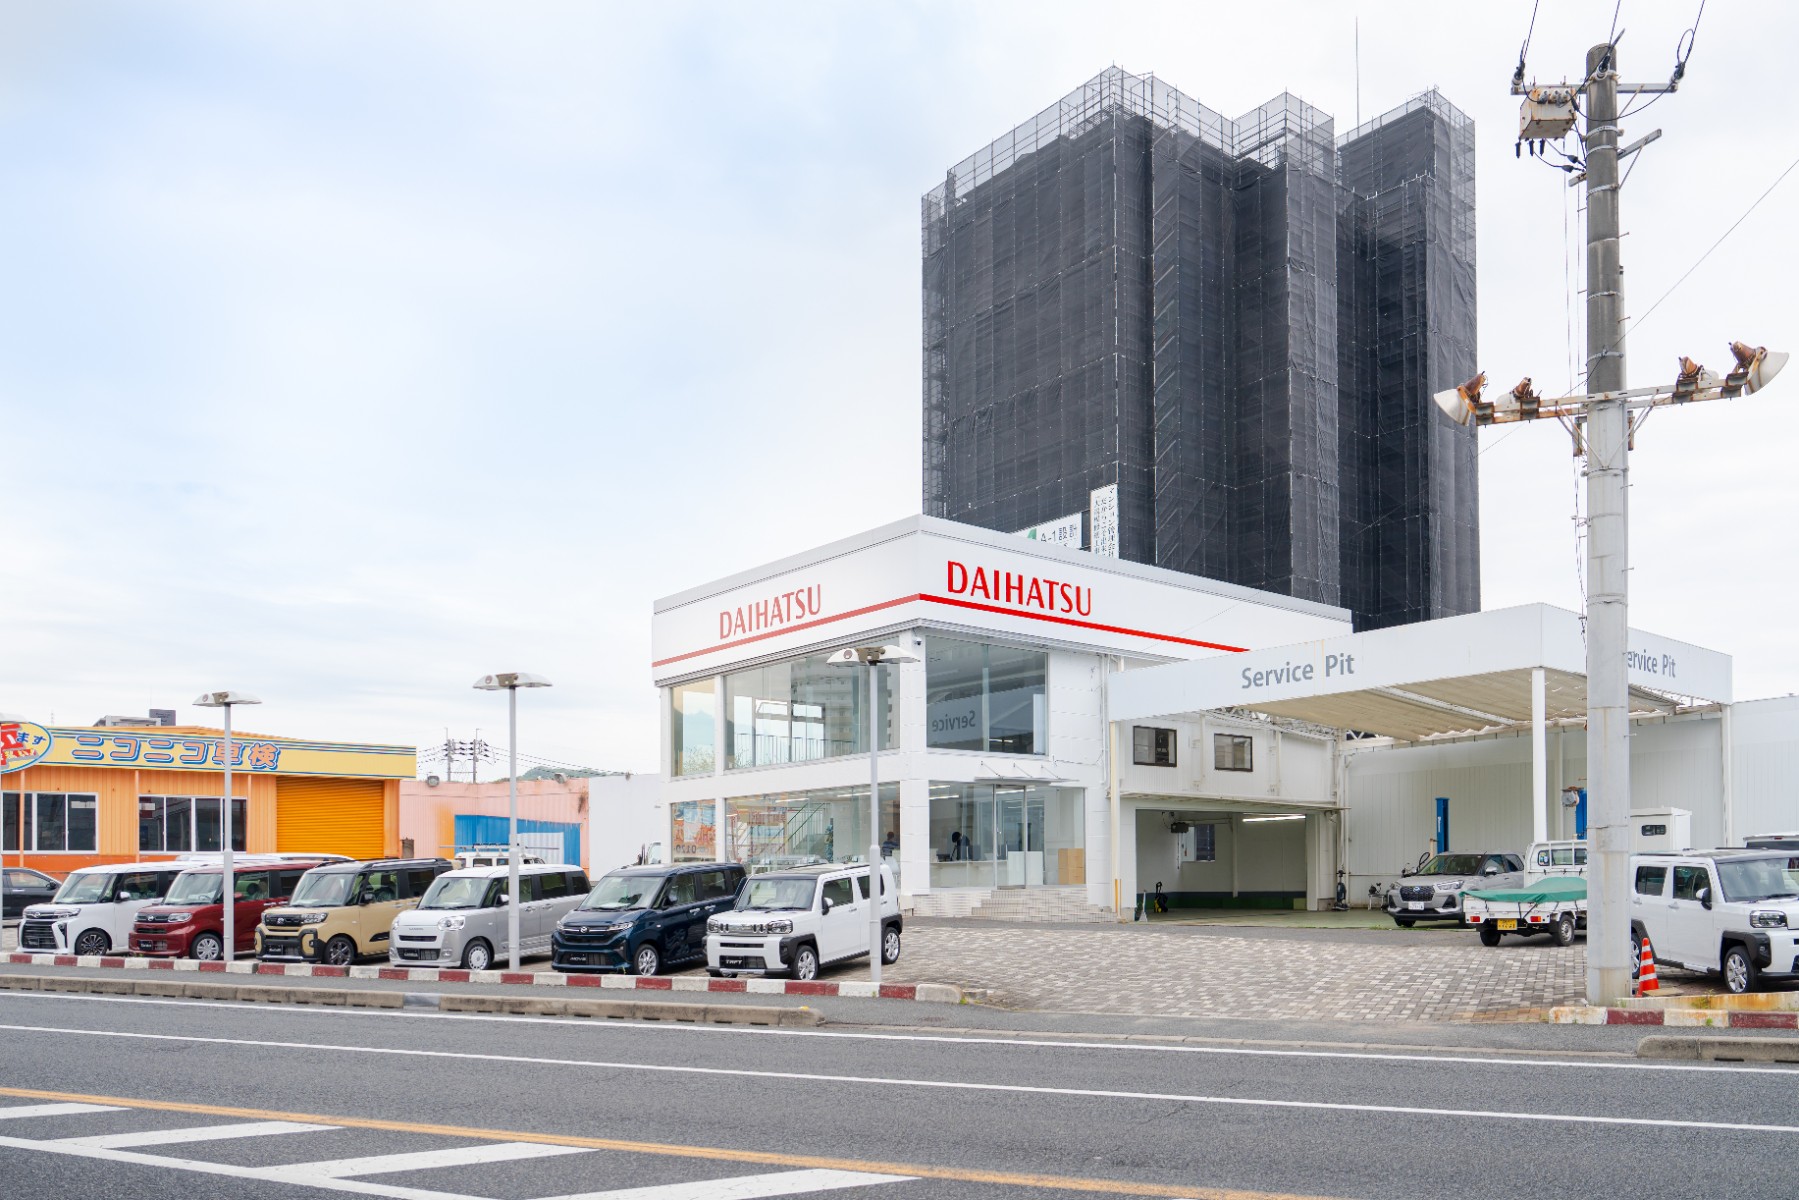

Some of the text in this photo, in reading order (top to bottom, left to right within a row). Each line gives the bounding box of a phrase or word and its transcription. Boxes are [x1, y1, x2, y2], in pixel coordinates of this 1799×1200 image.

[947, 560, 1091, 617] DAIHATSU
[719, 583, 821, 640] DAIHATSU
[1241, 652, 1355, 689] Service Pit
[1627, 649, 1676, 678] ervice Pit
[71, 735, 281, 770] ニコニコ車検
